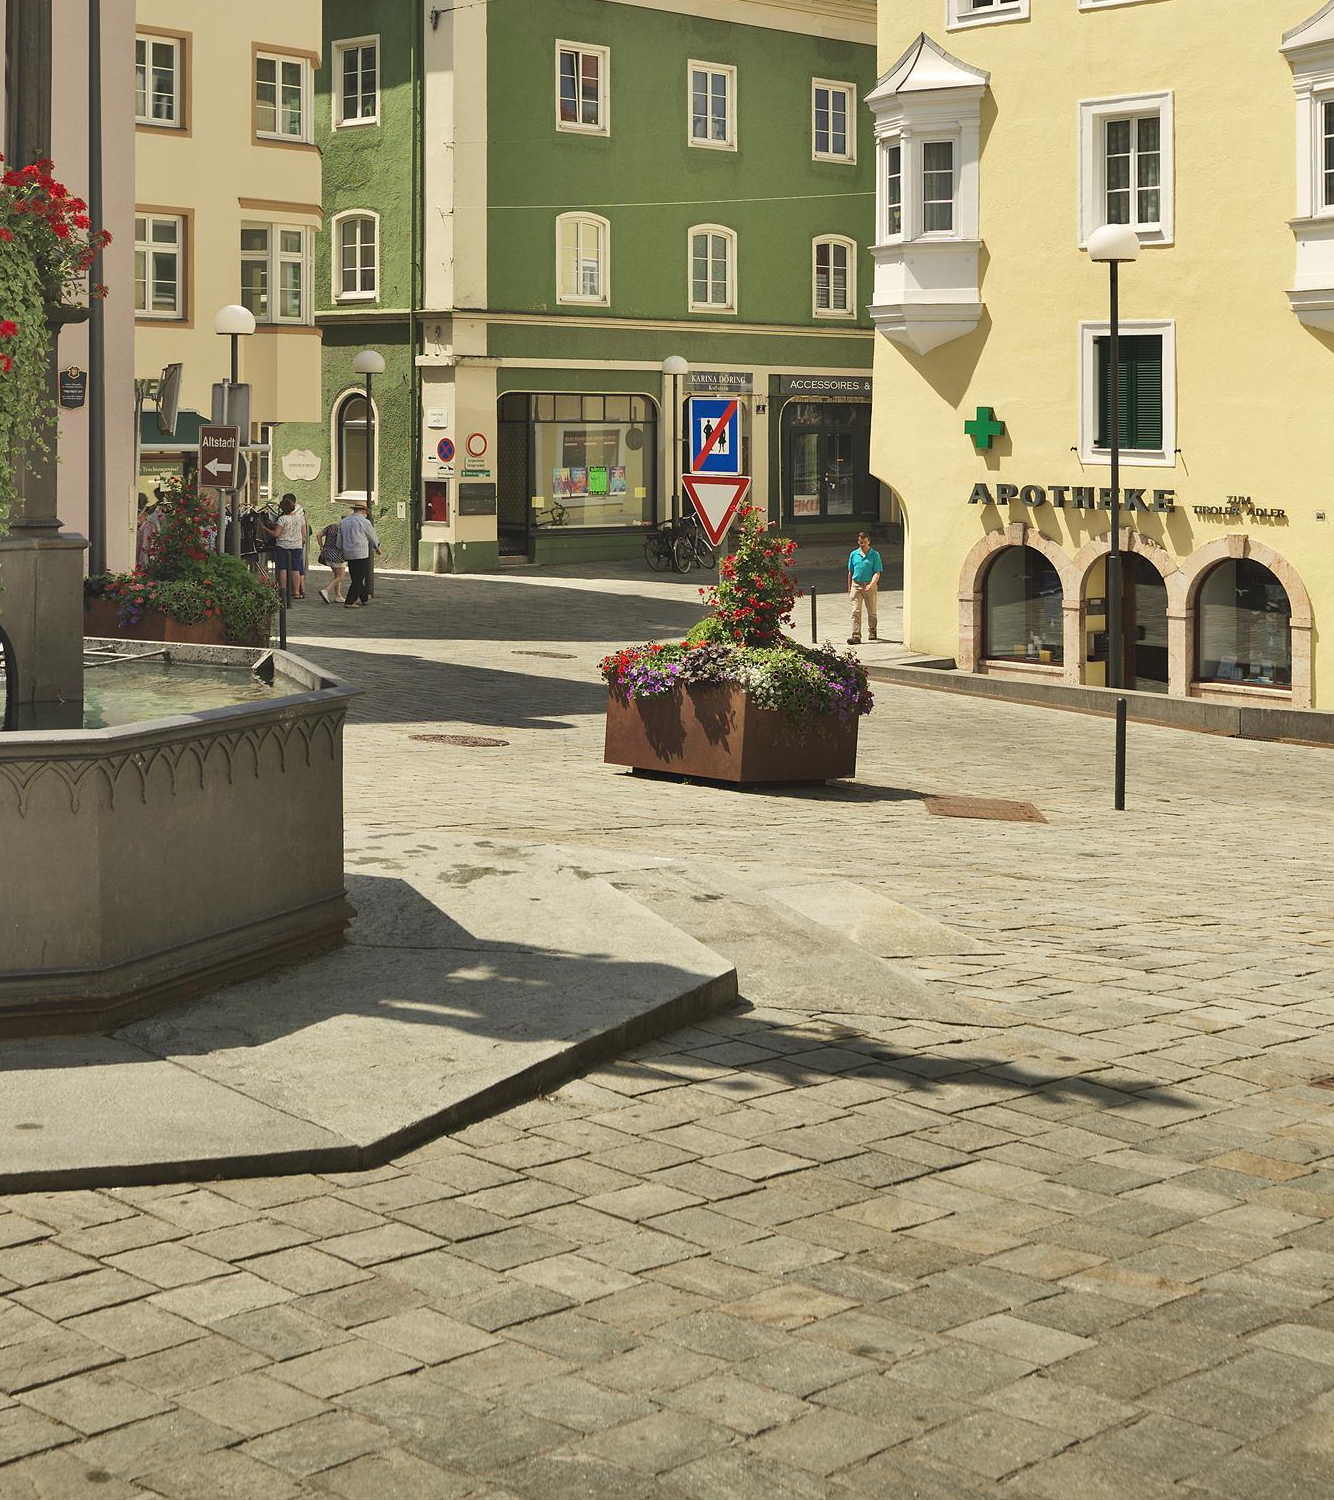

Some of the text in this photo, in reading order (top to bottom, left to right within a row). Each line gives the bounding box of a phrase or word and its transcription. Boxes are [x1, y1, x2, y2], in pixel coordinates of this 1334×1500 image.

[691, 374, 717, 384] KARINA
[790, 380, 871, 391] ACCESSOIRES &
[202, 436, 235, 449] Altstadt
[967, 482, 1176, 514] APOTHEKE
[1226, 495, 1252, 505] ZUM
[1192, 506, 1286, 518] TIROLER ADLER
